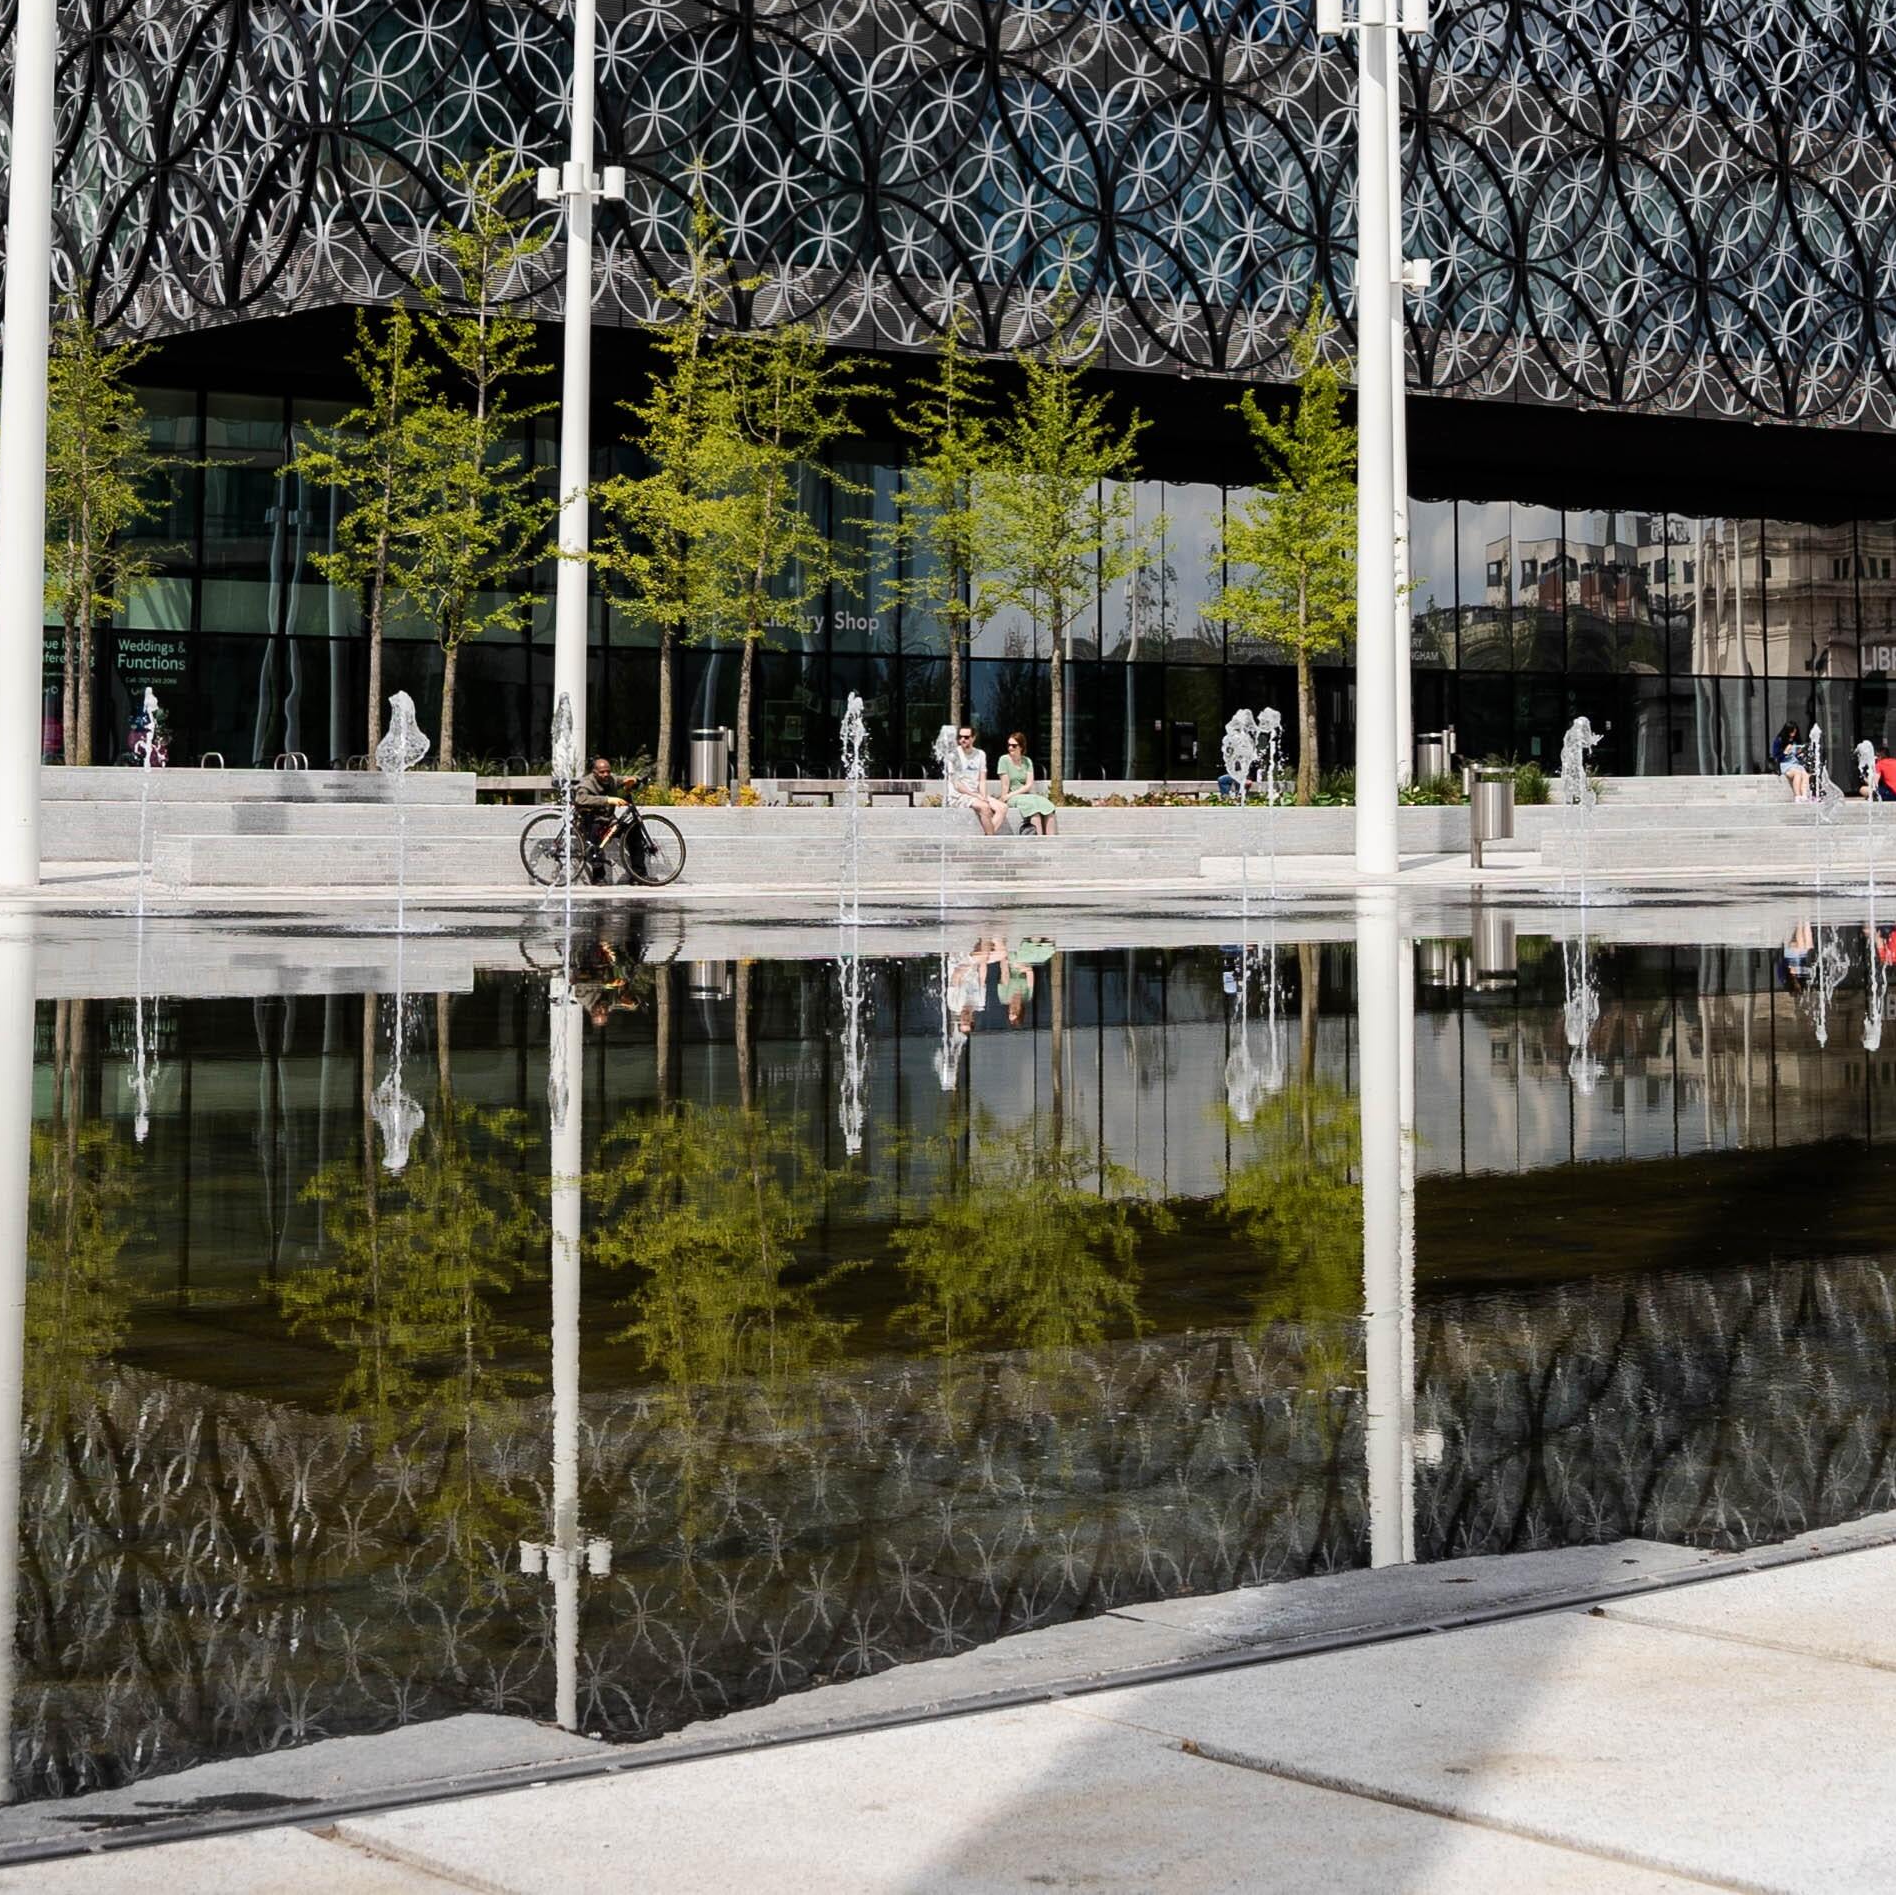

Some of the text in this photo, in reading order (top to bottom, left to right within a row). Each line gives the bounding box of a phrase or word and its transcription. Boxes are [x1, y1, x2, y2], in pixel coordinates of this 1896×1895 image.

[834, 610, 880, 635] Shop
[117, 639, 186, 656] Weddings &
[117, 653, 186, 670] Functions
